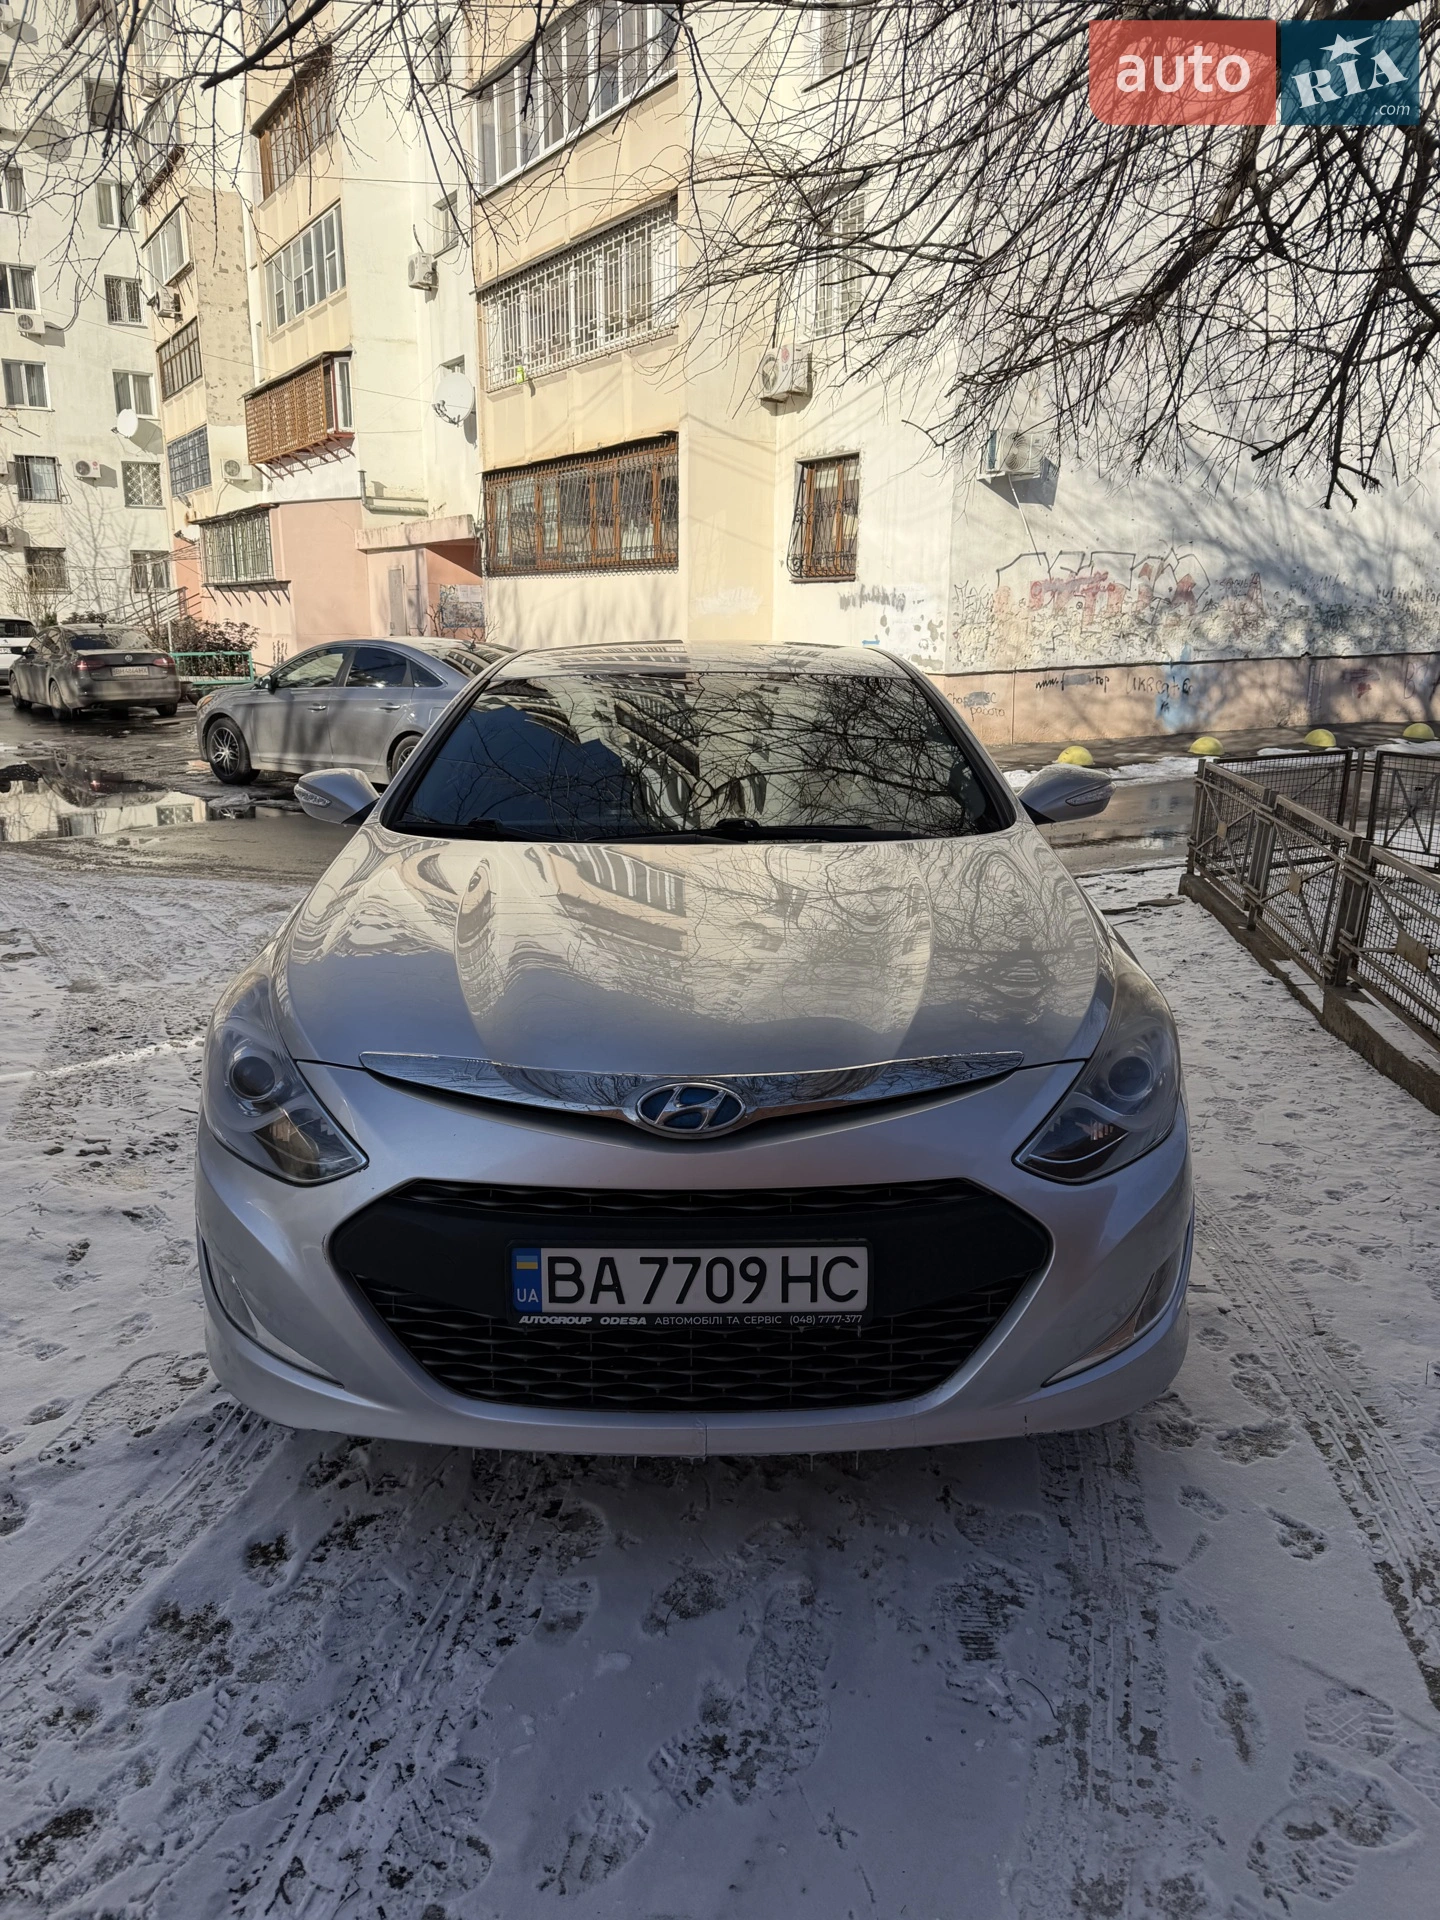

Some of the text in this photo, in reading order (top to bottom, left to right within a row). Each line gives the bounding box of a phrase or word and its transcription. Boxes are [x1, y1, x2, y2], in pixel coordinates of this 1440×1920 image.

[547, 1255, 860, 1305] BA 7709 HC
[516, 1288, 539, 1303] UA
[519, 1315, 647, 1325] AUTOGROUP ODESA
[654, 1314, 863, 1326] АВТОМОБІЛІ ТА СЕРВІС (048) 7777-377
